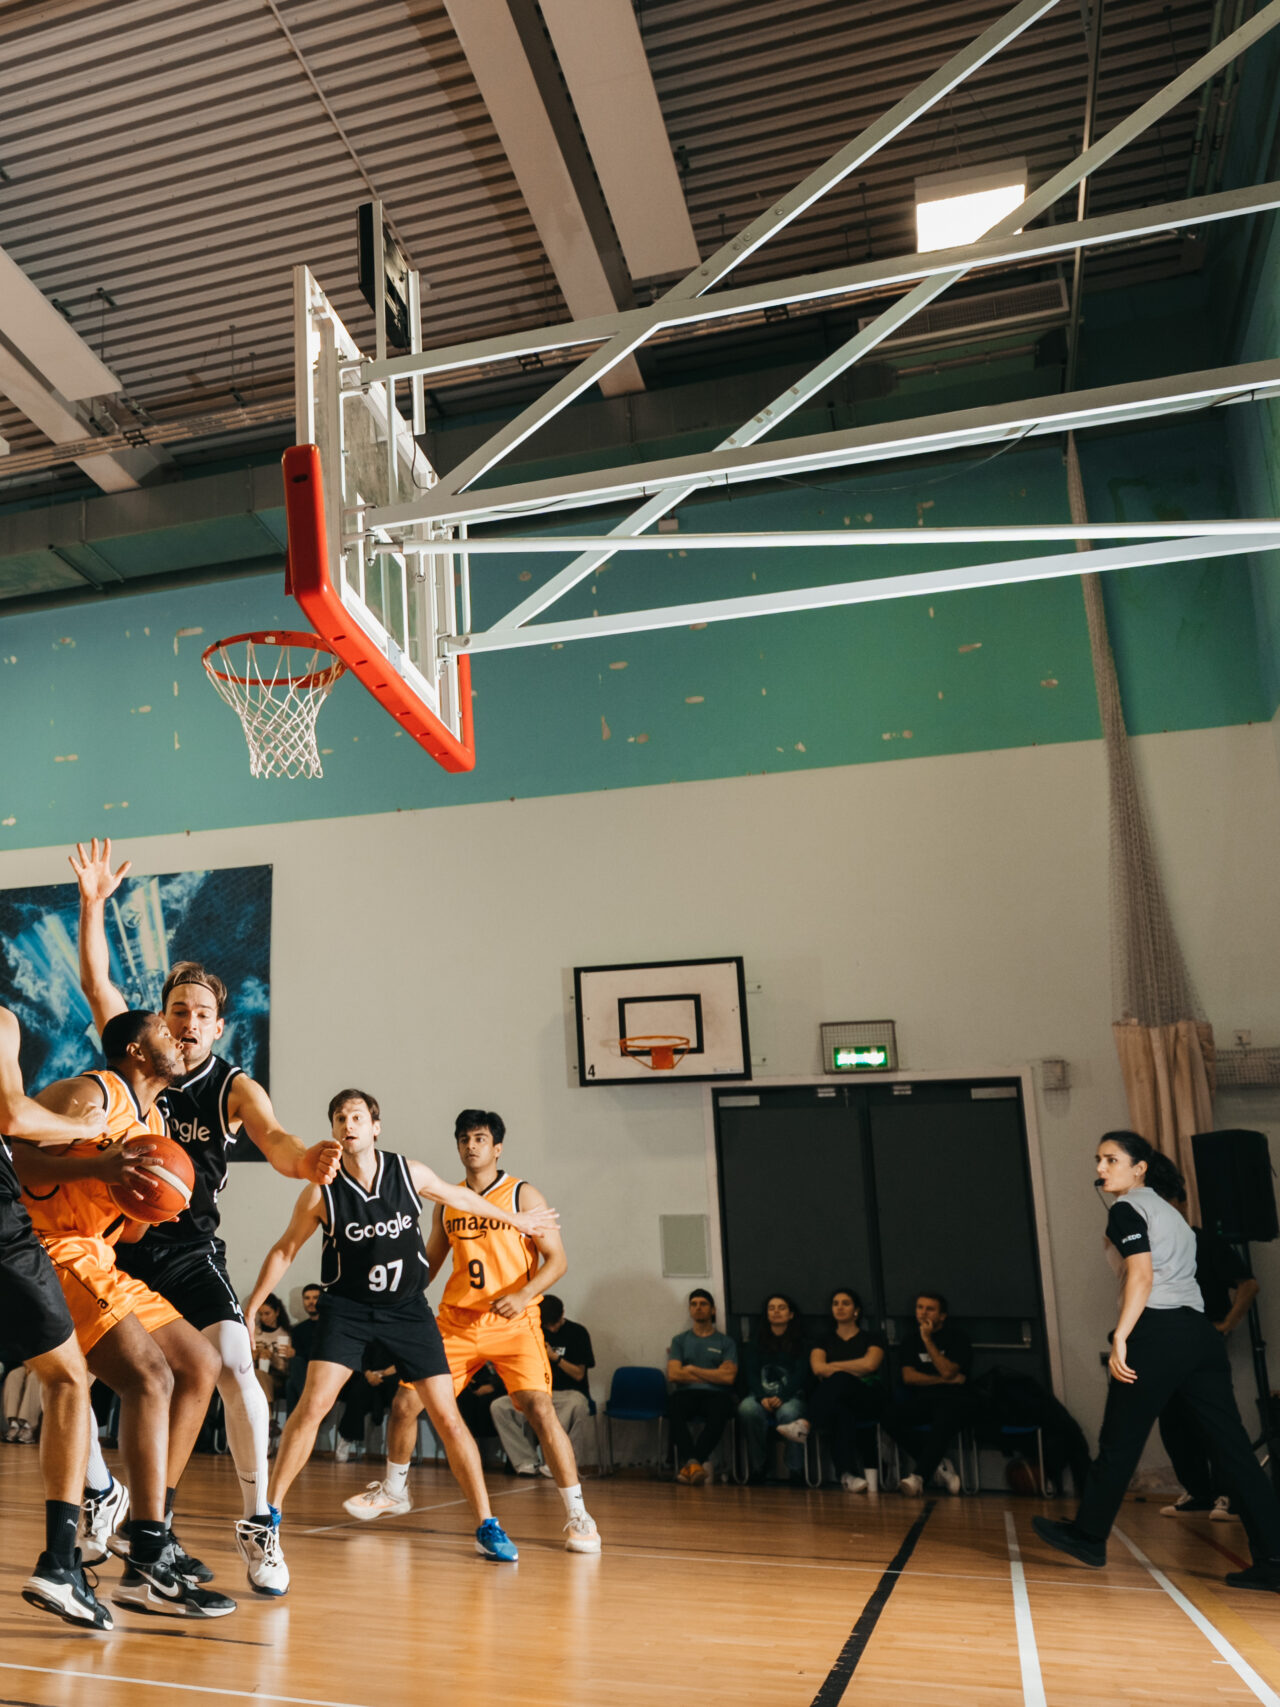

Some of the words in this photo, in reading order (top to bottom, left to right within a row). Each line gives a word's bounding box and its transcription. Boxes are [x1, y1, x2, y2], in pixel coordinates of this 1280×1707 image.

[588, 1064, 596, 1078] 4
[155, 1096, 211, 1143] Gogle
[345, 1212, 412, 1242] Google
[369, 1259, 403, 1292] 97
[468, 1259, 486, 1289] 9
